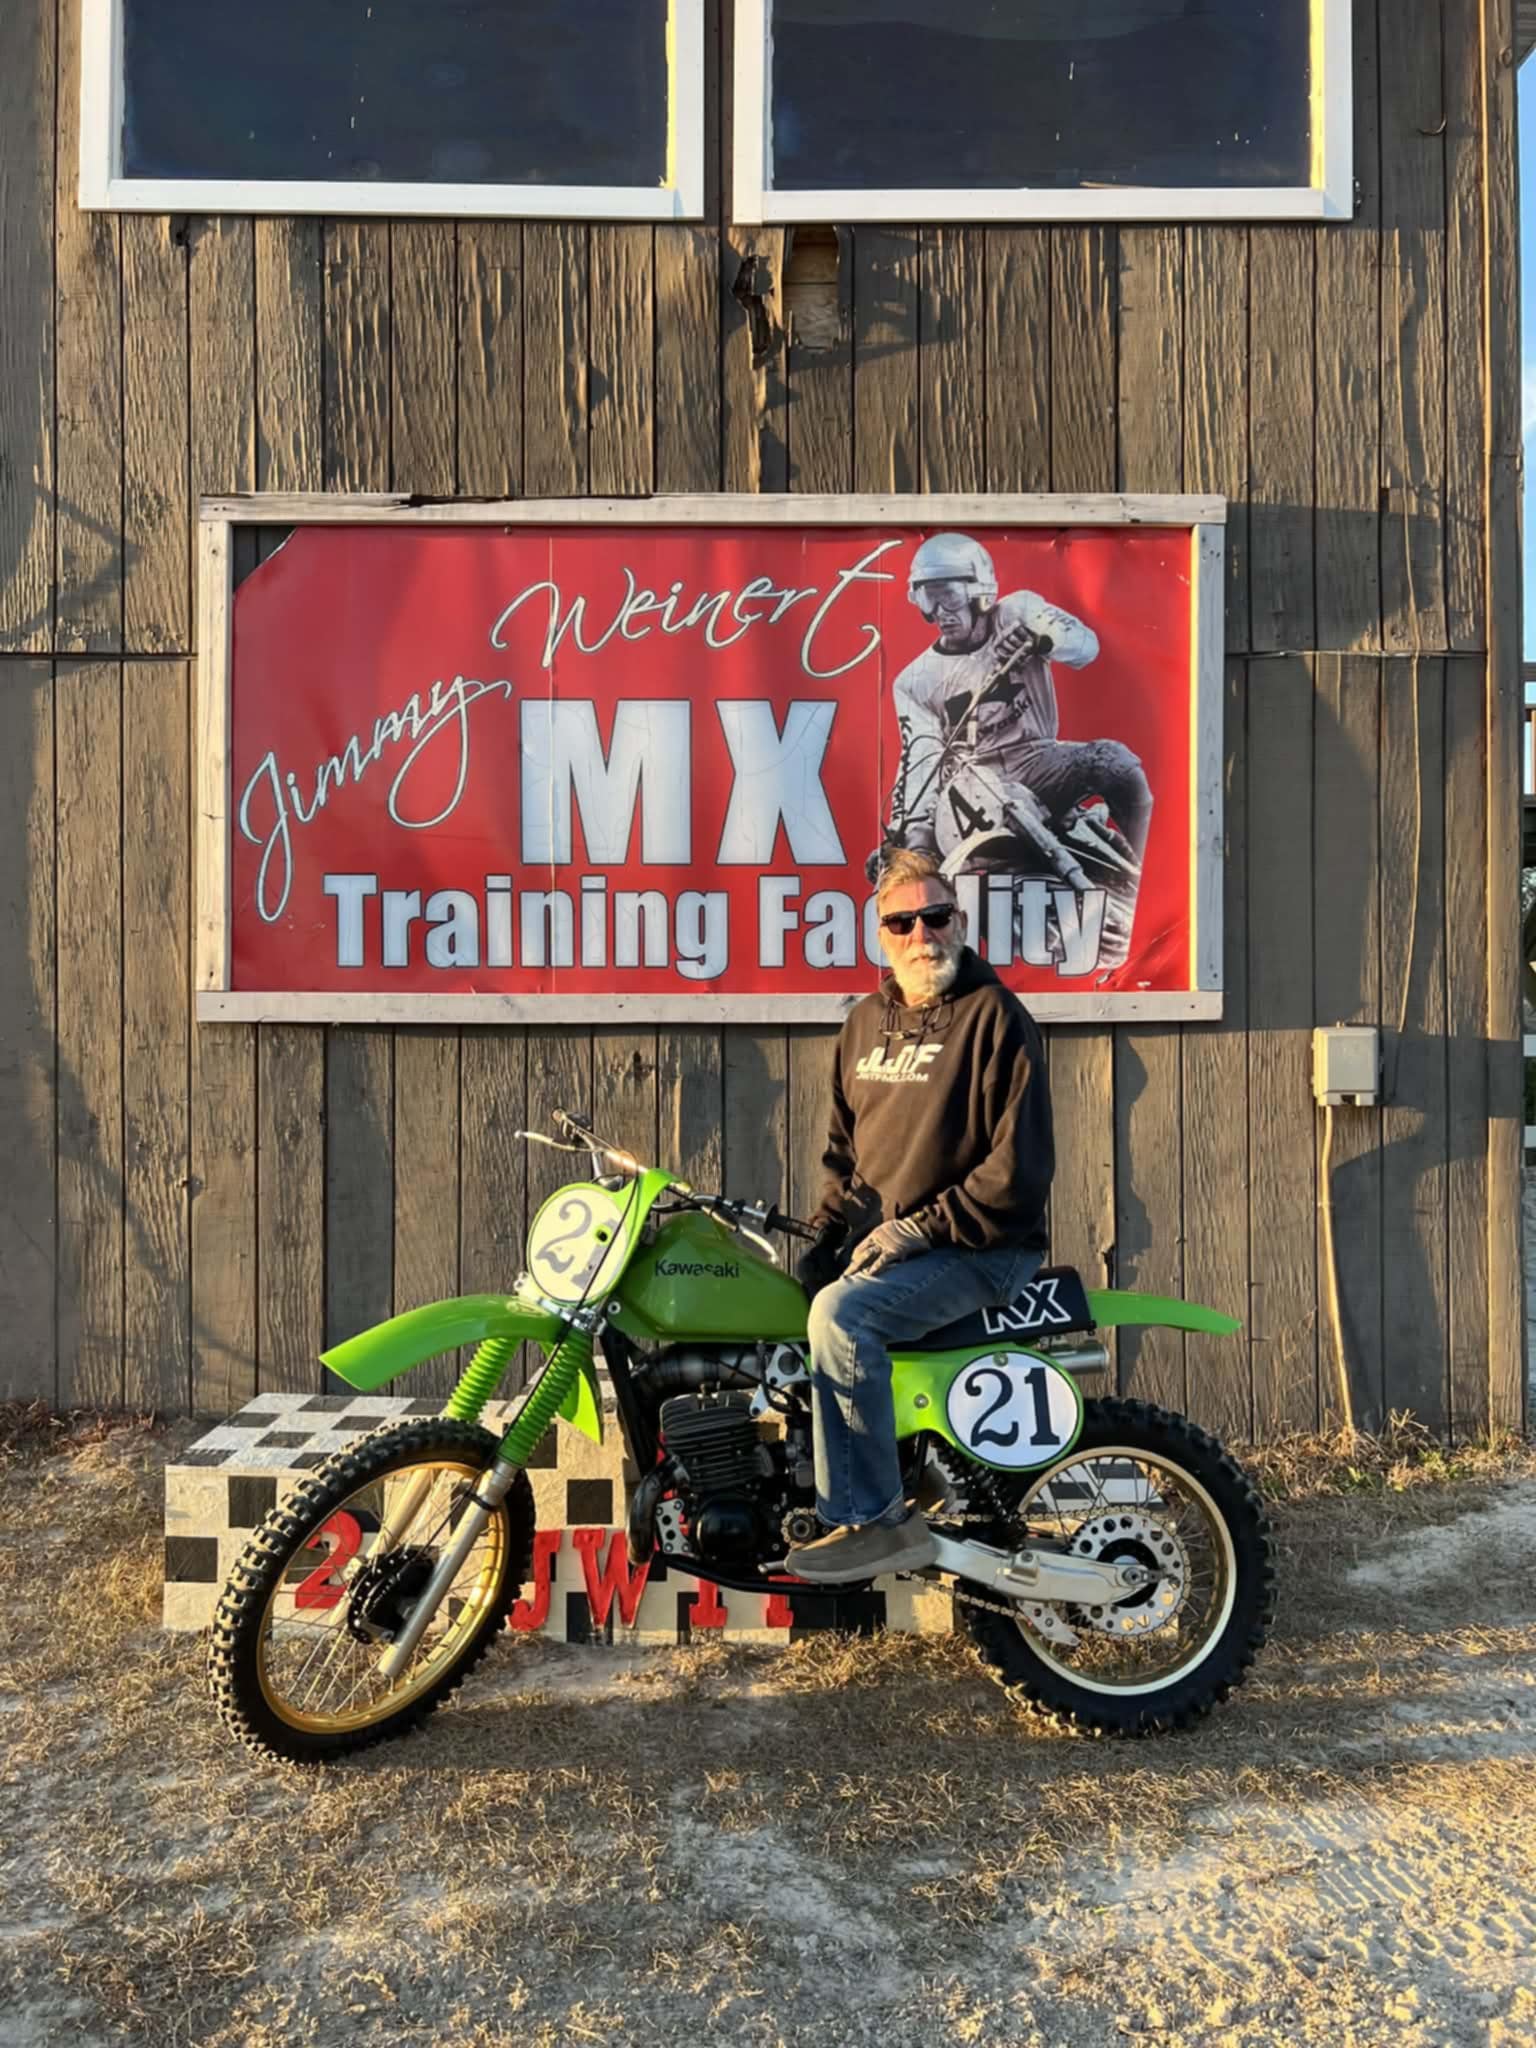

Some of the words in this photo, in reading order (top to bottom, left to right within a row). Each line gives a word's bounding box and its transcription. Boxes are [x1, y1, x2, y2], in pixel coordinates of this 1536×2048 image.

[239, 675, 512, 922] Jimmy
[489, 539, 903, 679] Weinert
[520, 700, 848, 866] MX
[948, 787, 993, 839] 4
[323, 875, 730, 980] Training
[758, 874, 1108, 977] Fality
[655, 1260, 740, 1278] Kawasaki
[965, 1367, 1060, 1447] 21
